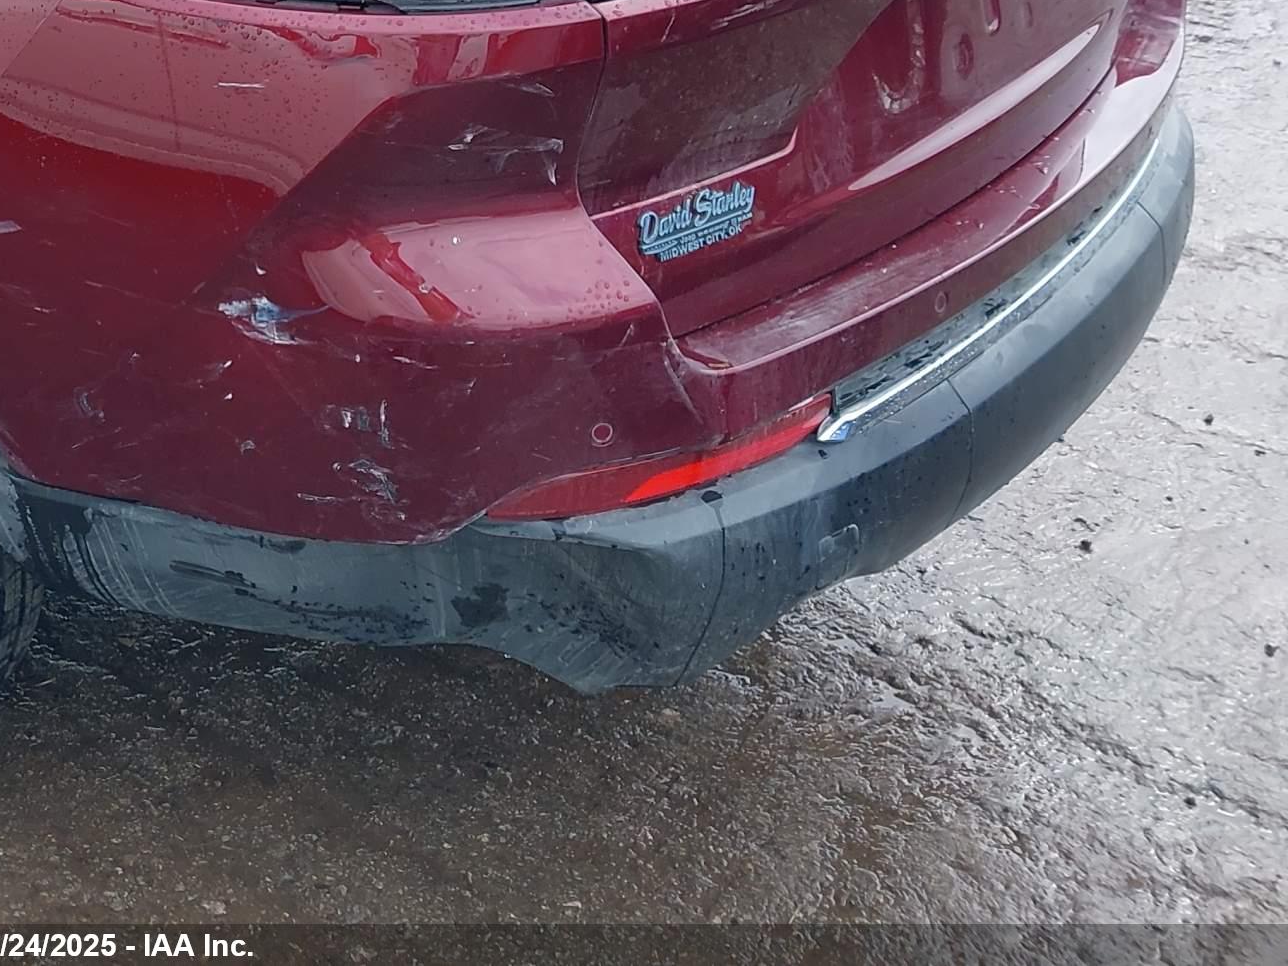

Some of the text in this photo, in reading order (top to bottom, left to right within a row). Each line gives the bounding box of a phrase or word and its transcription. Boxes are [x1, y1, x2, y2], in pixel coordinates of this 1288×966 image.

[640, 181, 756, 244] David Stanley
[659, 238, 705, 262] MIDWEST
[728, 223, 743, 236] OK
